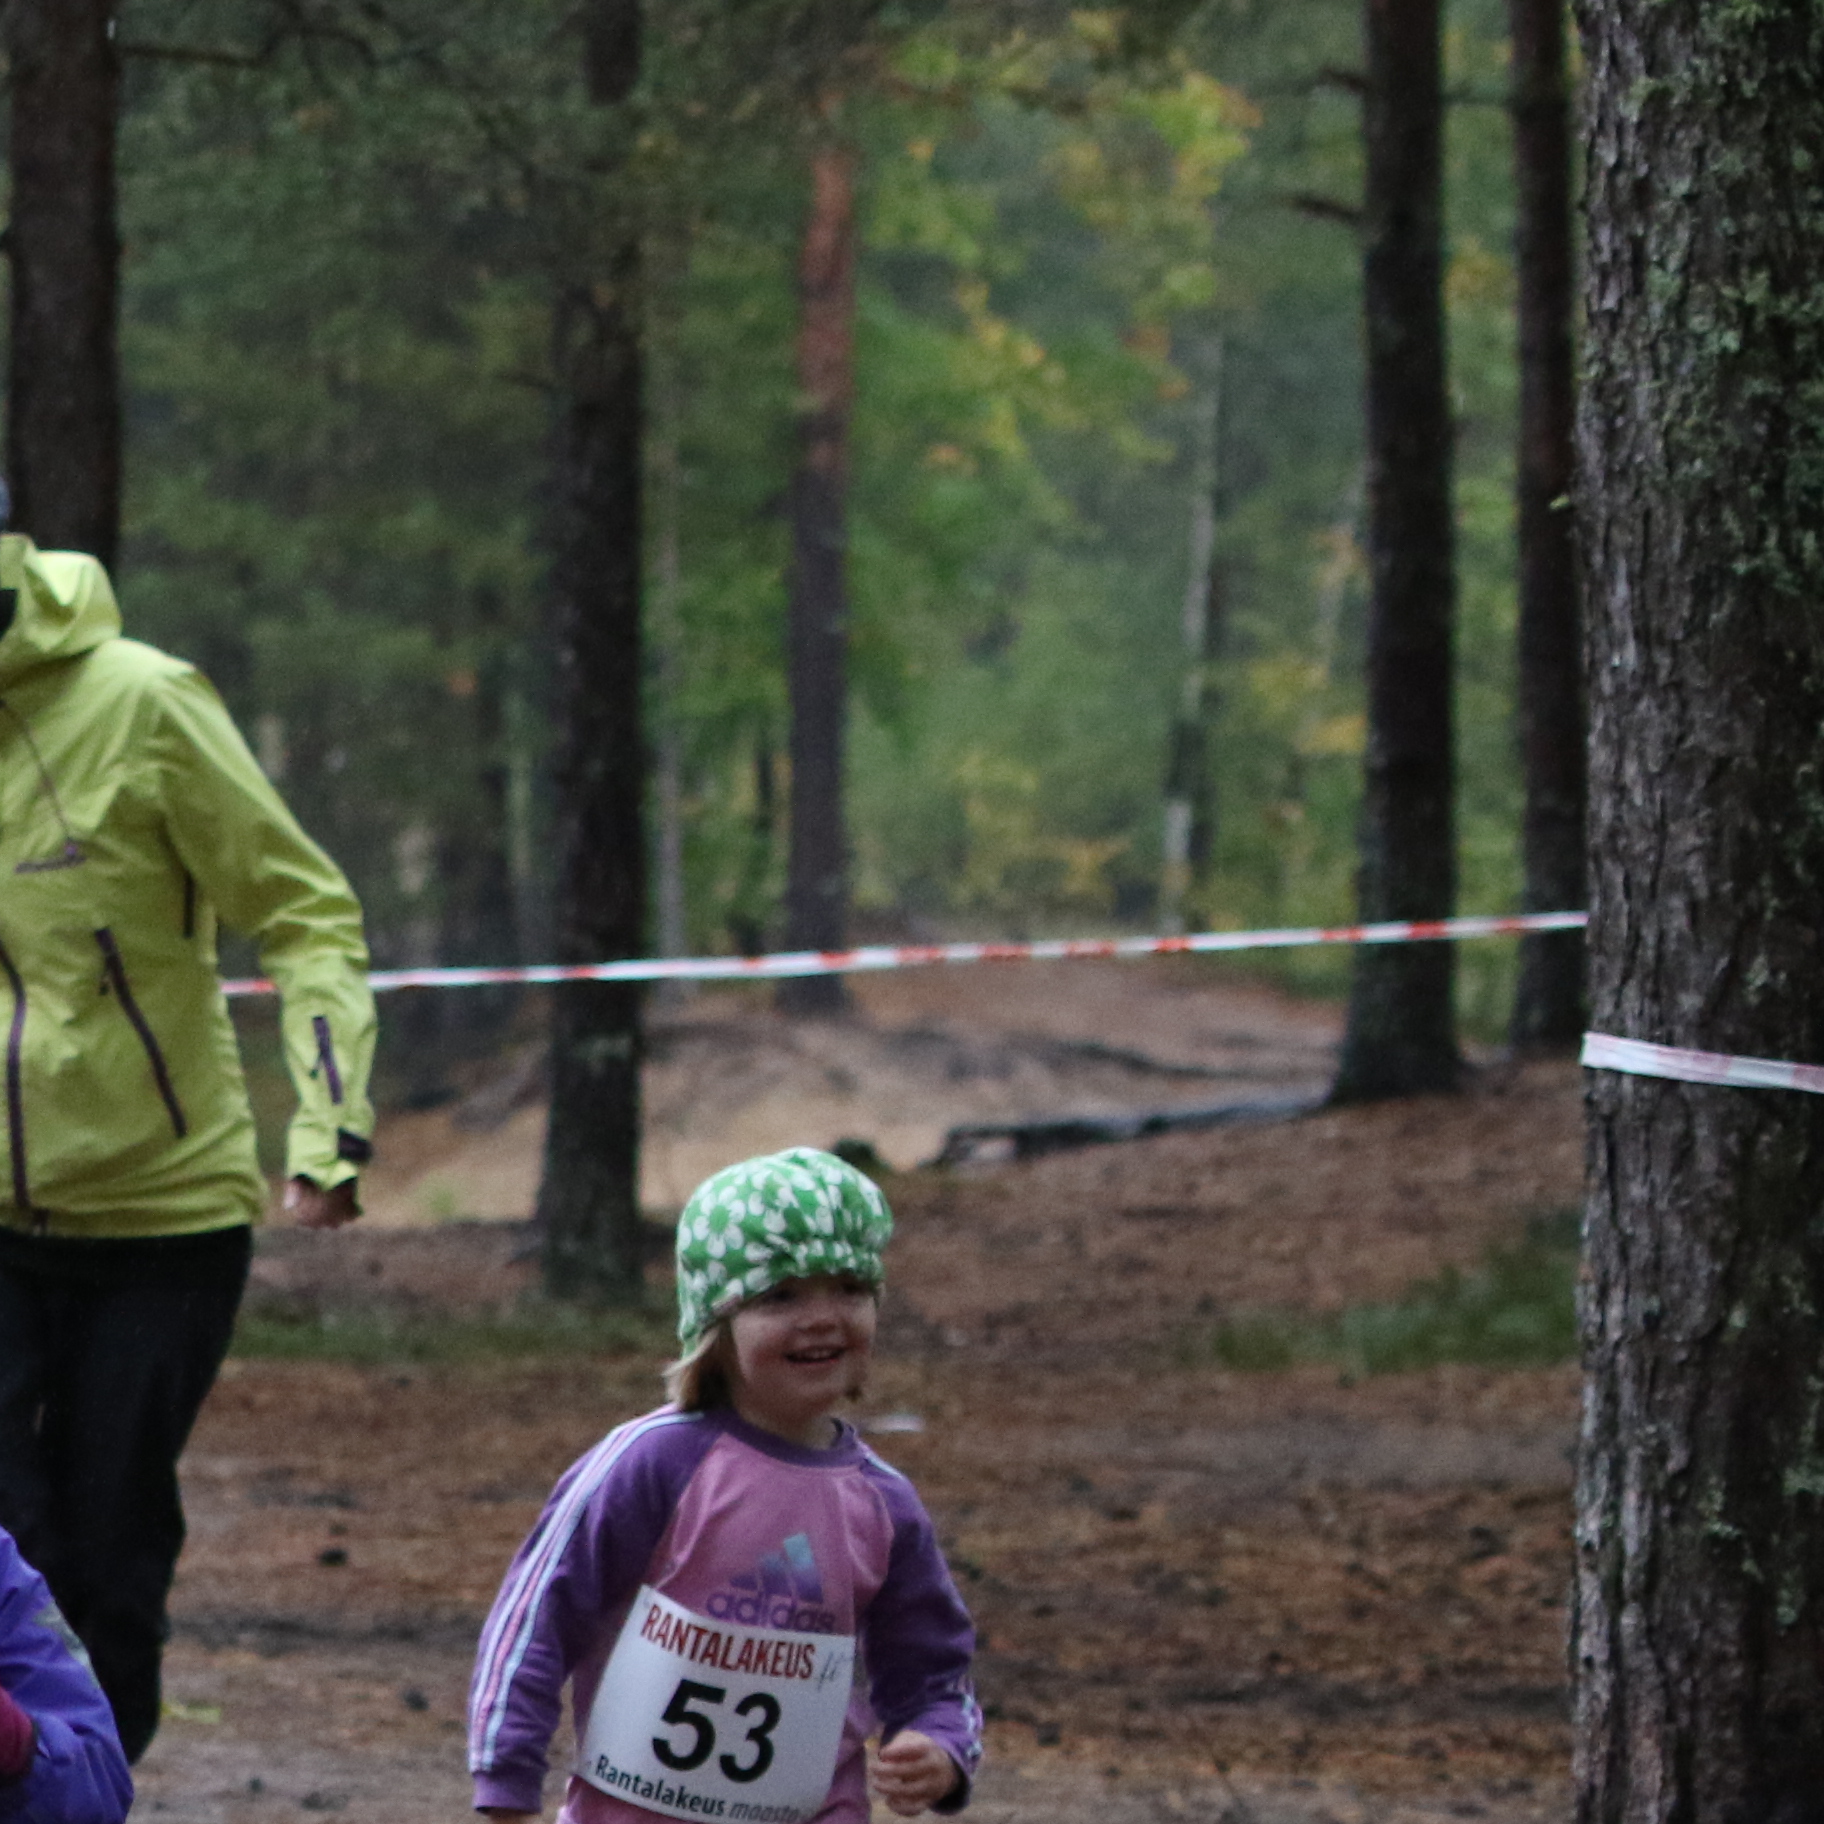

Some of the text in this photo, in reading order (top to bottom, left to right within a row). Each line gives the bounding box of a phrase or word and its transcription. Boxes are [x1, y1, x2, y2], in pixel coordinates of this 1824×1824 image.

[707, 1590, 836, 1633] adidas
[652, 1679, 781, 1783] 53
[595, 1755, 800, 1824] Rantalakeus maasto
